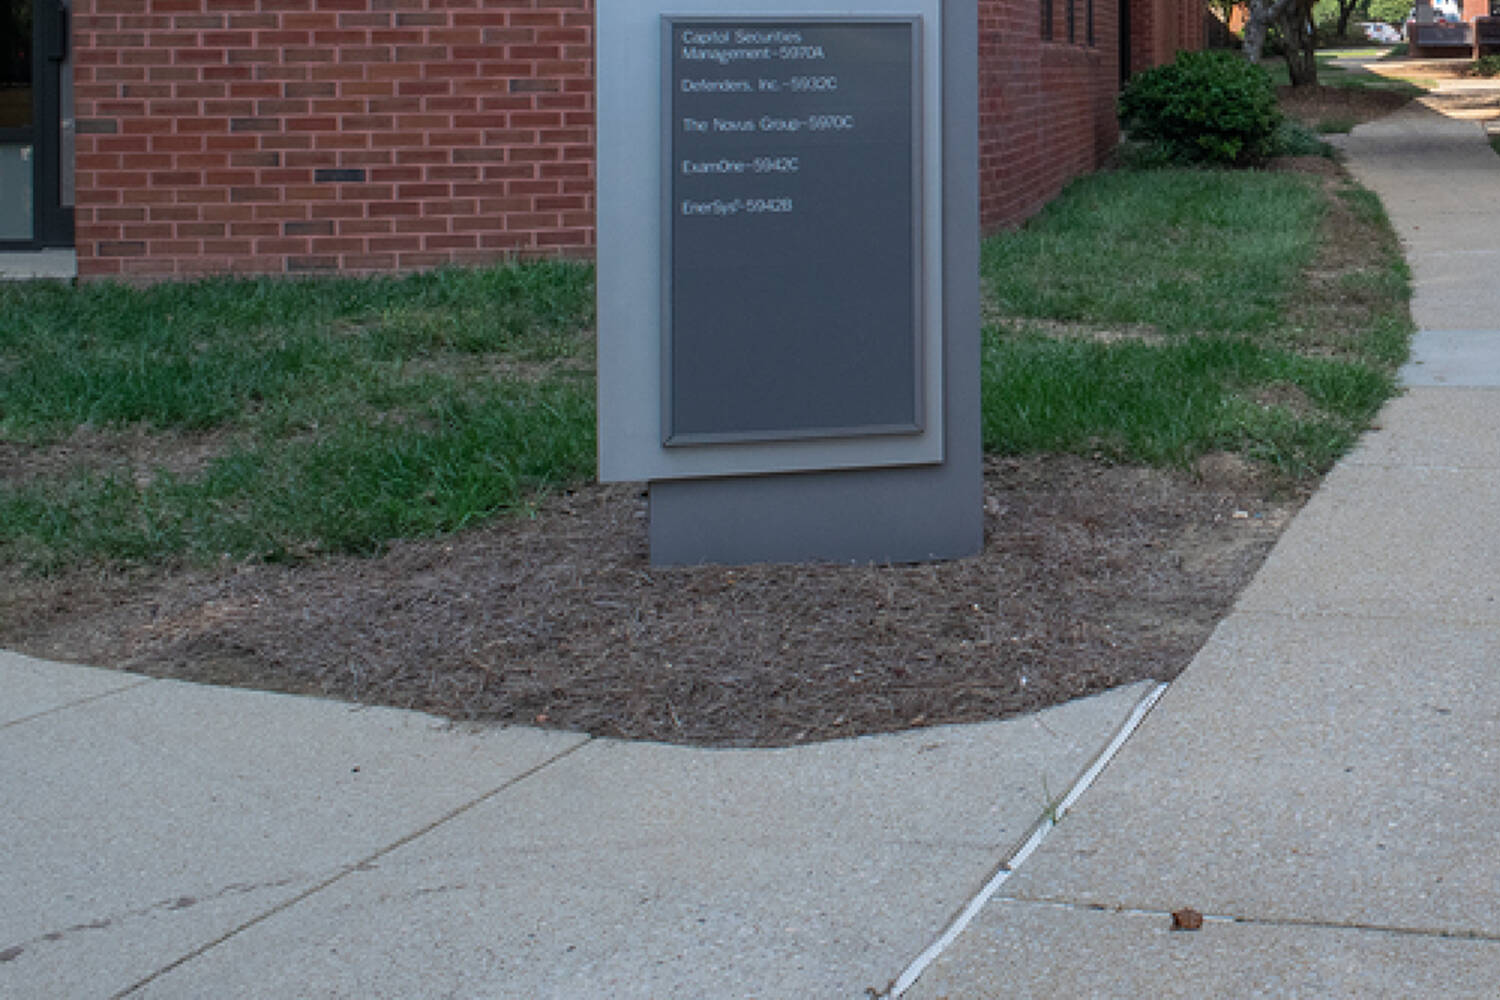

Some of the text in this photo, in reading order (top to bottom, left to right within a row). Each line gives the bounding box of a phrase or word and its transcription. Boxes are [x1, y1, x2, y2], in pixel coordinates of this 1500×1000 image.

[682, 30, 802, 44] Capitol Securities
[683, 118, 709, 131] The
[713, 117, 755, 131] Novus
